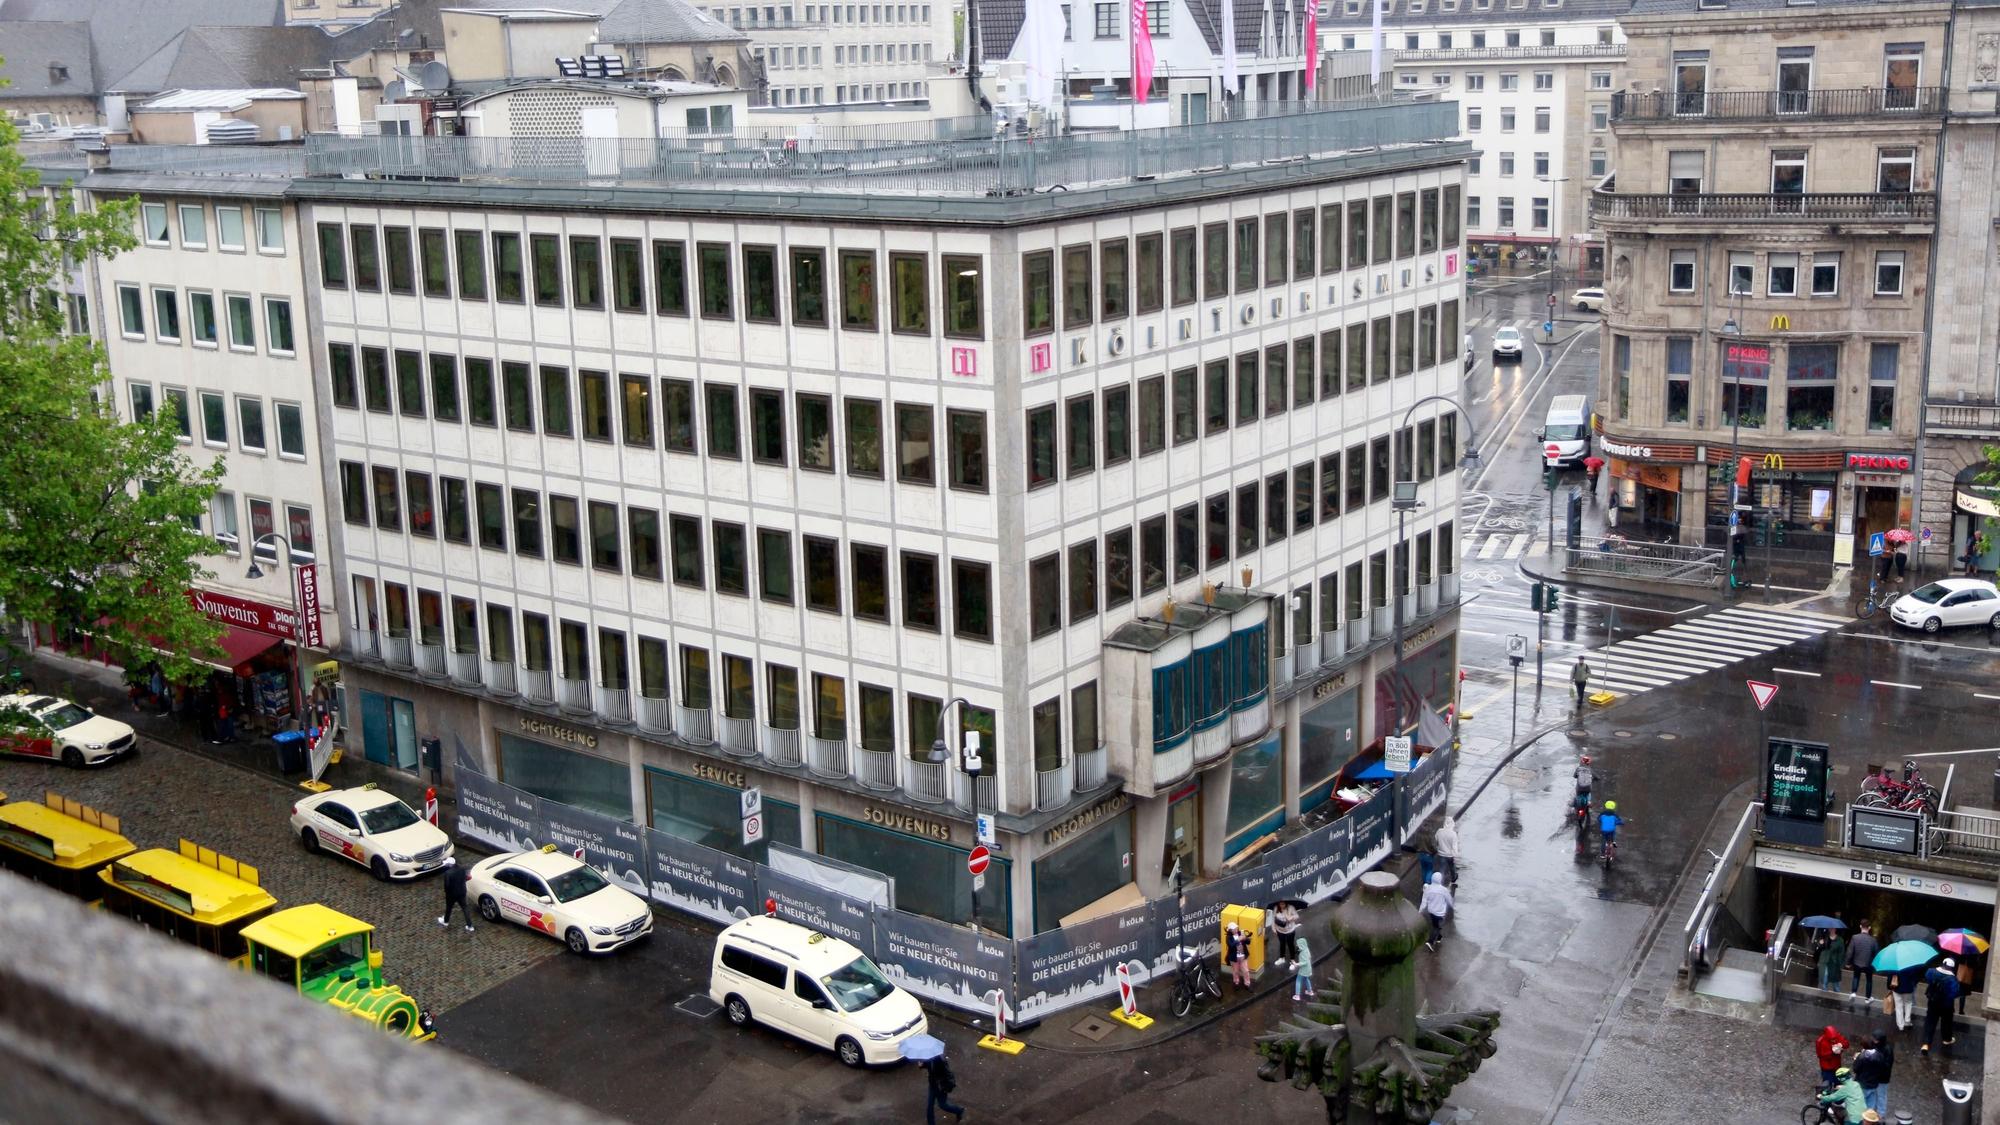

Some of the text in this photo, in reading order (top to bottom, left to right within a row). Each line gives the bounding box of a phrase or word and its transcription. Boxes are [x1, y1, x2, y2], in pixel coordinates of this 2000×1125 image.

[1849, 455, 1910, 470] PEKING
[196, 592, 259, 625] Souvenirs
[304, 579, 319, 645] SOUVENIRS
[277, 624, 289, 633] FREE
[520, 718, 598, 749] SIGHTSEEING
[692, 763, 745, 788] SERVICE
[1773, 763, 1807, 775] Endlich
[1773, 773, 1806, 782] wieder
[1773, 780, 1818, 792] Spargeld-
[1773, 788, 1790, 798] Zeit
[464, 797, 524, 829] DIE NEUE KÖLN INFO
[863, 807, 952, 841] SOUVENIRS
[1047, 794, 1130, 844] INFORMATION
[550, 821, 603, 843] Wir bauen für Sie
[551, 831, 564, 843] DIE
[564, 834, 586, 849] NEUE
[586, 839, 606, 855] KÖLN
[607, 849, 625, 861] INFO
[657, 851, 713, 877] Wir bauen für Sie
[731, 865, 747, 877] KÖLN
[1271, 880, 1283, 892] DIE
[1283, 870, 1301, 887] NEUE
[1302, 862, 1319, 879] KÖLN
[1319, 855, 1334, 869] INFO
[1866, 873, 1876, 882] 16
[1880, 874, 1892, 884] 18
[659, 862, 672, 875] DIE
[672, 866, 694, 882] NEUE
[694, 872, 716, 889] KÖLN
[717, 883, 735, 896] INFO
[768, 888, 827, 917] Wir bauen für Sie
[847, 904, 864, 918] KÖLN
[1203, 904, 1214, 918] für
[1214, 901, 1226, 912] Sie
[775, 902, 784, 914] IE
[784, 904, 807, 923] NEUE
[807, 912, 830, 930] KÖLN
[831, 922, 851, 937] INFO
[1126, 916, 1144, 928] KÖLN
[1165, 911, 1221, 940] DIE NEUE KÖL
[888, 930, 958, 959] Wir bauen für Sie
[984, 943, 1004, 958] KÖLN
[1032, 940, 1101, 970] Wir bauen für Sie
[889, 942, 906, 956] DIE
[907, 946, 933, 964] NEUE
[934, 953, 961, 973] KÖLN
[962, 963, 987, 980] INFO
[1032, 968, 1049, 982] DIE
[1050, 960, 1077, 977] NEUE
[1077, 951, 1104, 970] KÖLN
[1105, 944, 1128, 961] INFO
